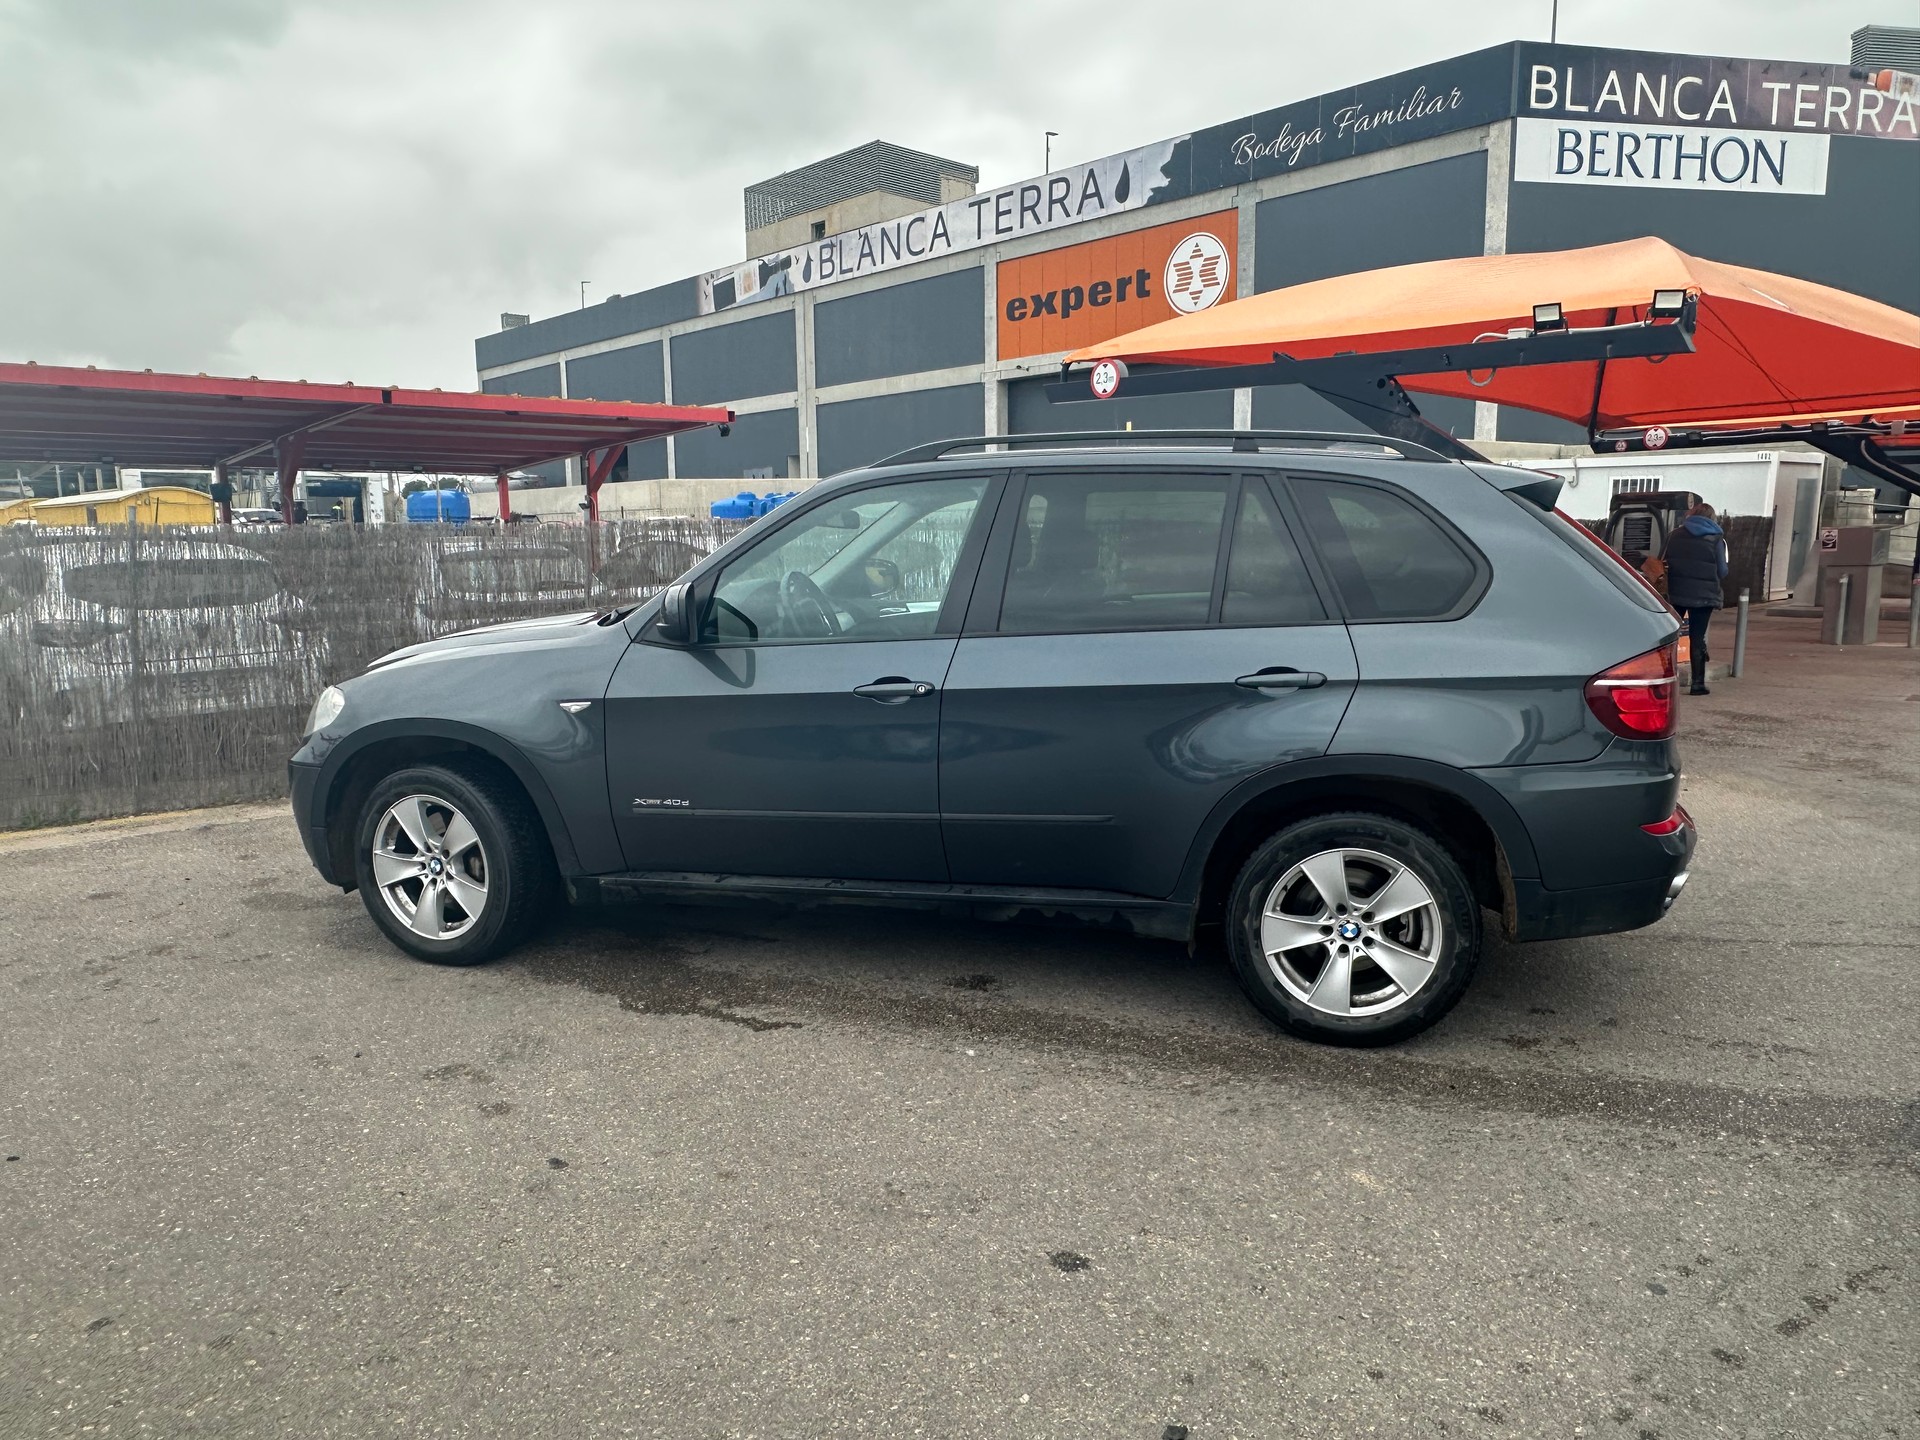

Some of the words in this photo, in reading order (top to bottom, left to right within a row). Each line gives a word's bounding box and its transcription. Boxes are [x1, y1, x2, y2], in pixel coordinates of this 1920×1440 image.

[1231, 122, 1326, 166] Bodega
[1333, 86, 1464, 138] Familiar
[1530, 64, 1737, 124] BLANCA
[1762, 82, 1918, 135] TERRA
[1555, 128, 1787, 186] BERTHON
[819, 210, 952, 280] BLANCA
[968, 168, 1105, 240] TERRA
[1006, 268, 1151, 322] expert
